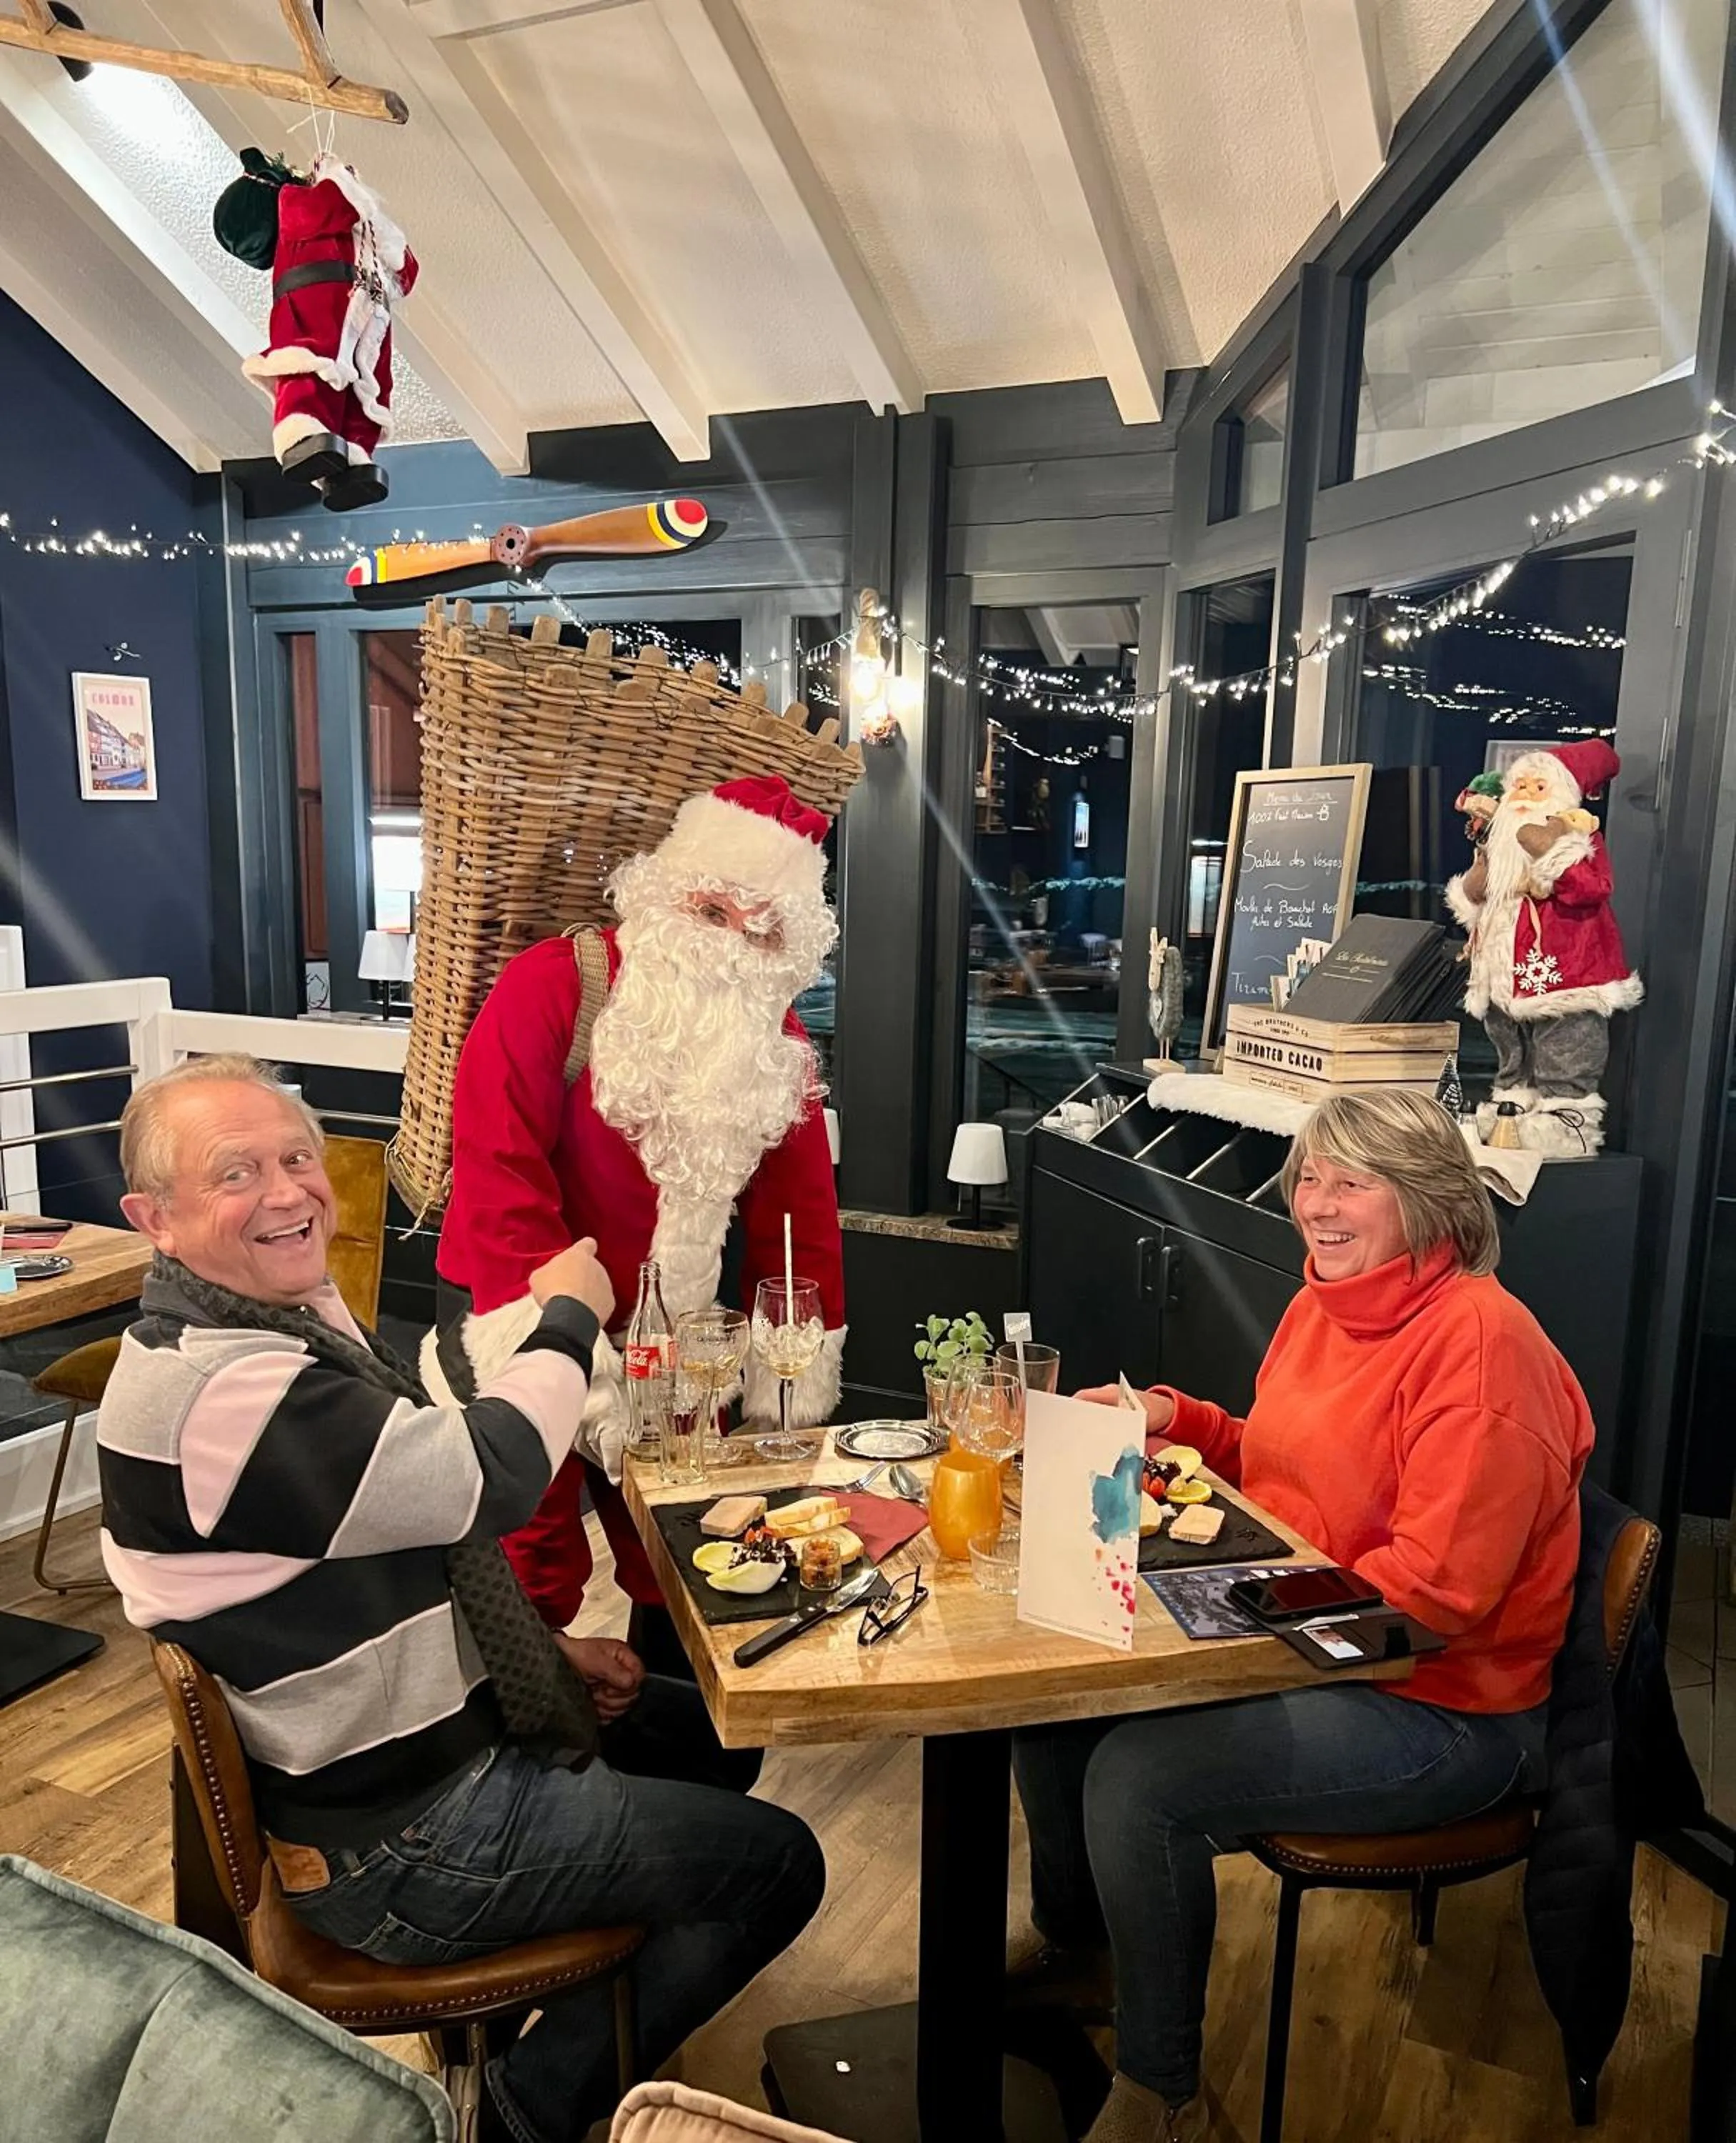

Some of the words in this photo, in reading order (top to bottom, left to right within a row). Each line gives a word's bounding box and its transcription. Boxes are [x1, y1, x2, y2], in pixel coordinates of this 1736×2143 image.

[1239, 839, 1281, 872] Salade
[1289, 848, 1306, 867] des
[1236, 1040, 1284, 1063] IMPORTED
[1288, 1051, 1323, 1072] CACAO
